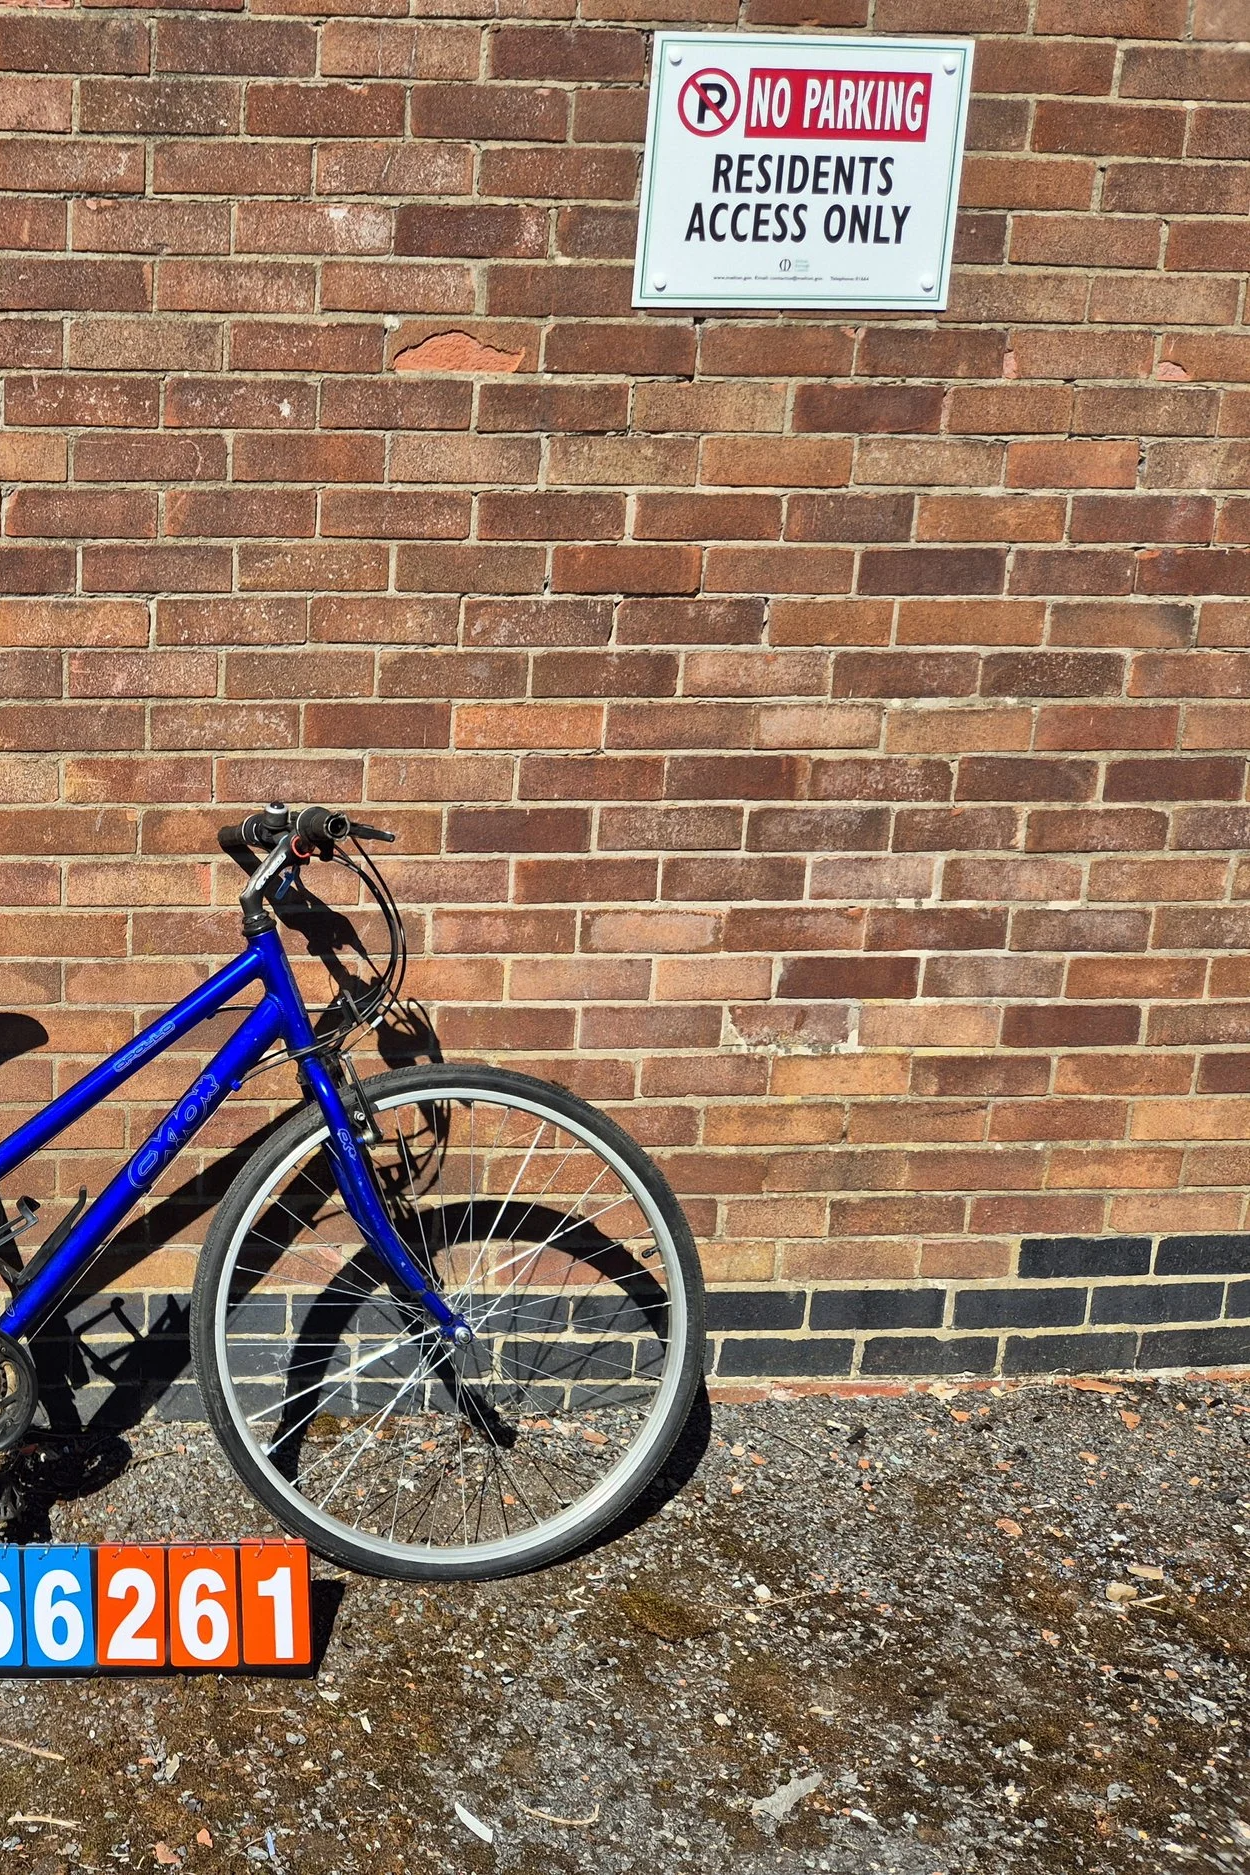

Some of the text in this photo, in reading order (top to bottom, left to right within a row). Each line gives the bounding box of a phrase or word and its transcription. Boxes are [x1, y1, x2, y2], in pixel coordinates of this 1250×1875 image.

[749, 77, 925, 132] NO PARKING
[712, 154, 895, 197] RESIDENTS
[684, 202, 912, 245] ACCESS ONLY
